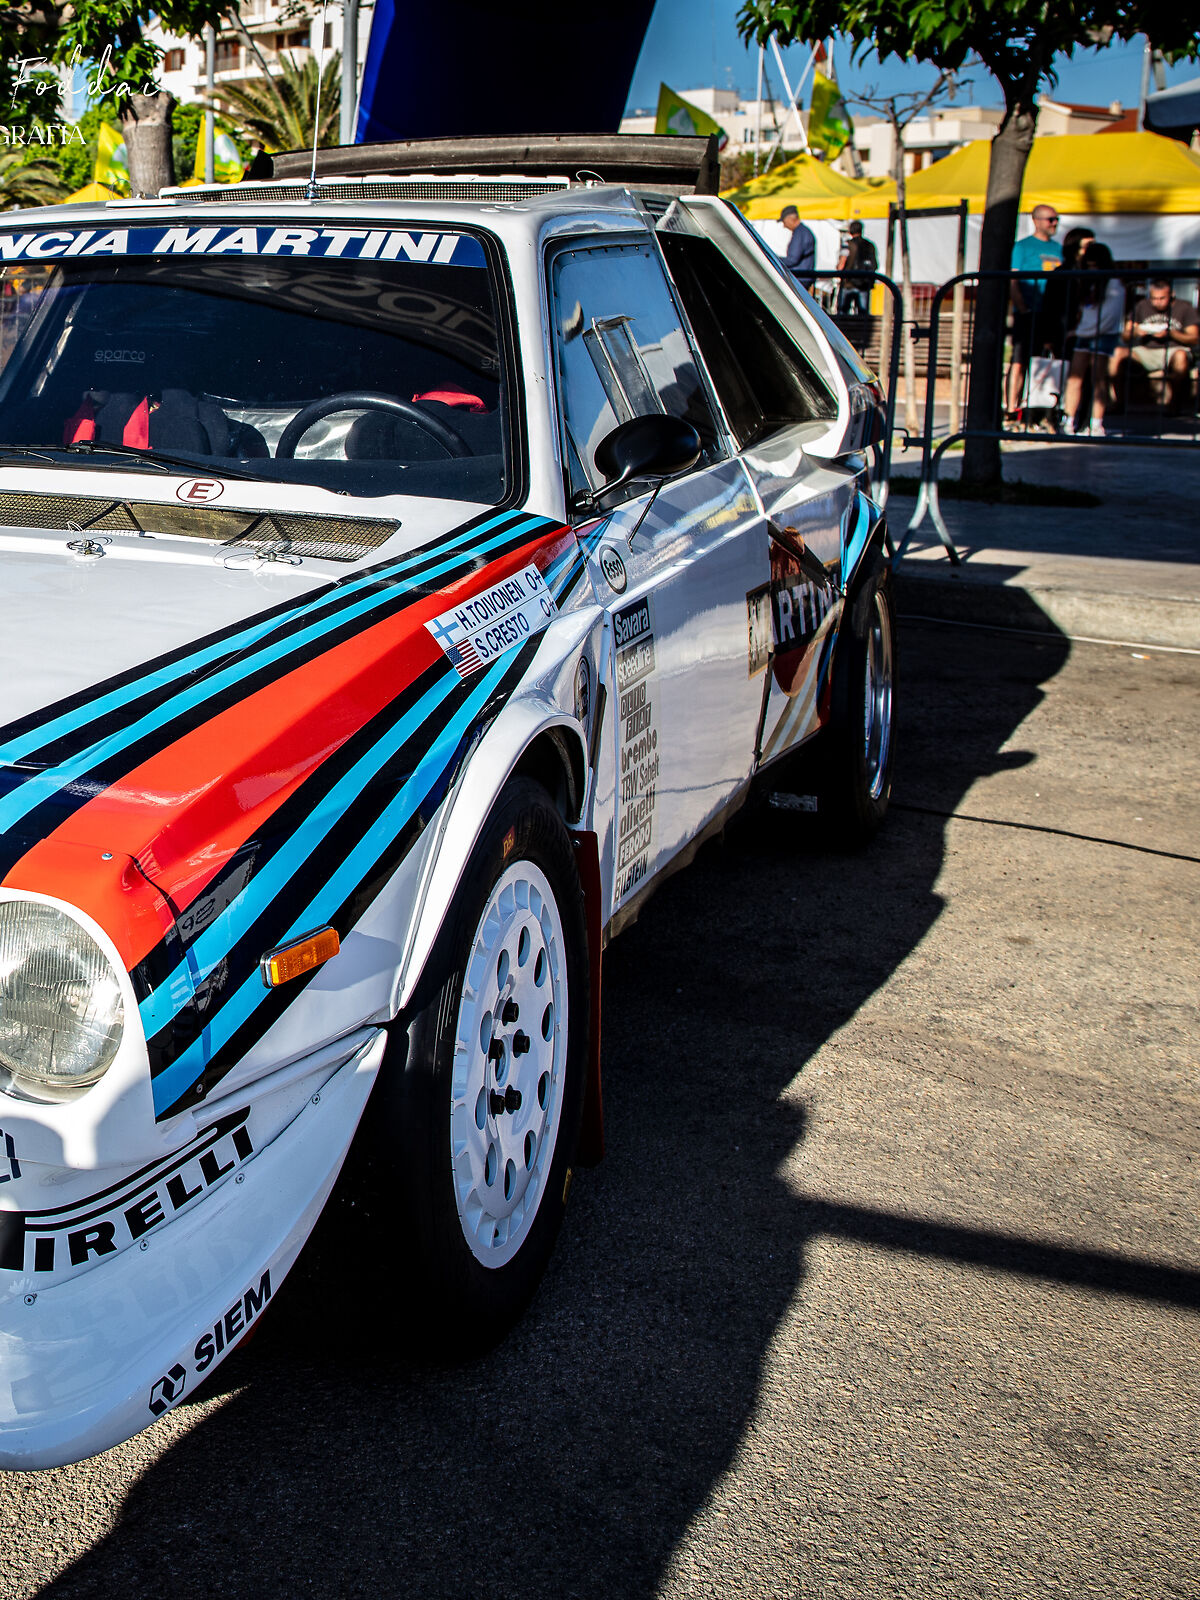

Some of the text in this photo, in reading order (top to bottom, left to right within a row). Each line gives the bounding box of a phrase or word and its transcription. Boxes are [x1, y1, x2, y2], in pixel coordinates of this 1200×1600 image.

[152, 228, 460, 264] MARTINI
[187, 482, 215, 499] E
[603, 559, 623, 580] Esso
[455, 578, 526, 631] H.TOIVONEN
[615, 606, 650, 645] Savara
[474, 612, 530, 660] S.CRESTO
[621, 685, 645, 716] OLIO
[627, 706, 651, 738] FIAT
[622, 727, 657, 774] brembo
[620, 783, 656, 838] olivetti
[619, 826, 651, 869] FERODO
[615, 851, 649, 901] BILSTEIN
[194, 1268, 273, 1373] SIEM
